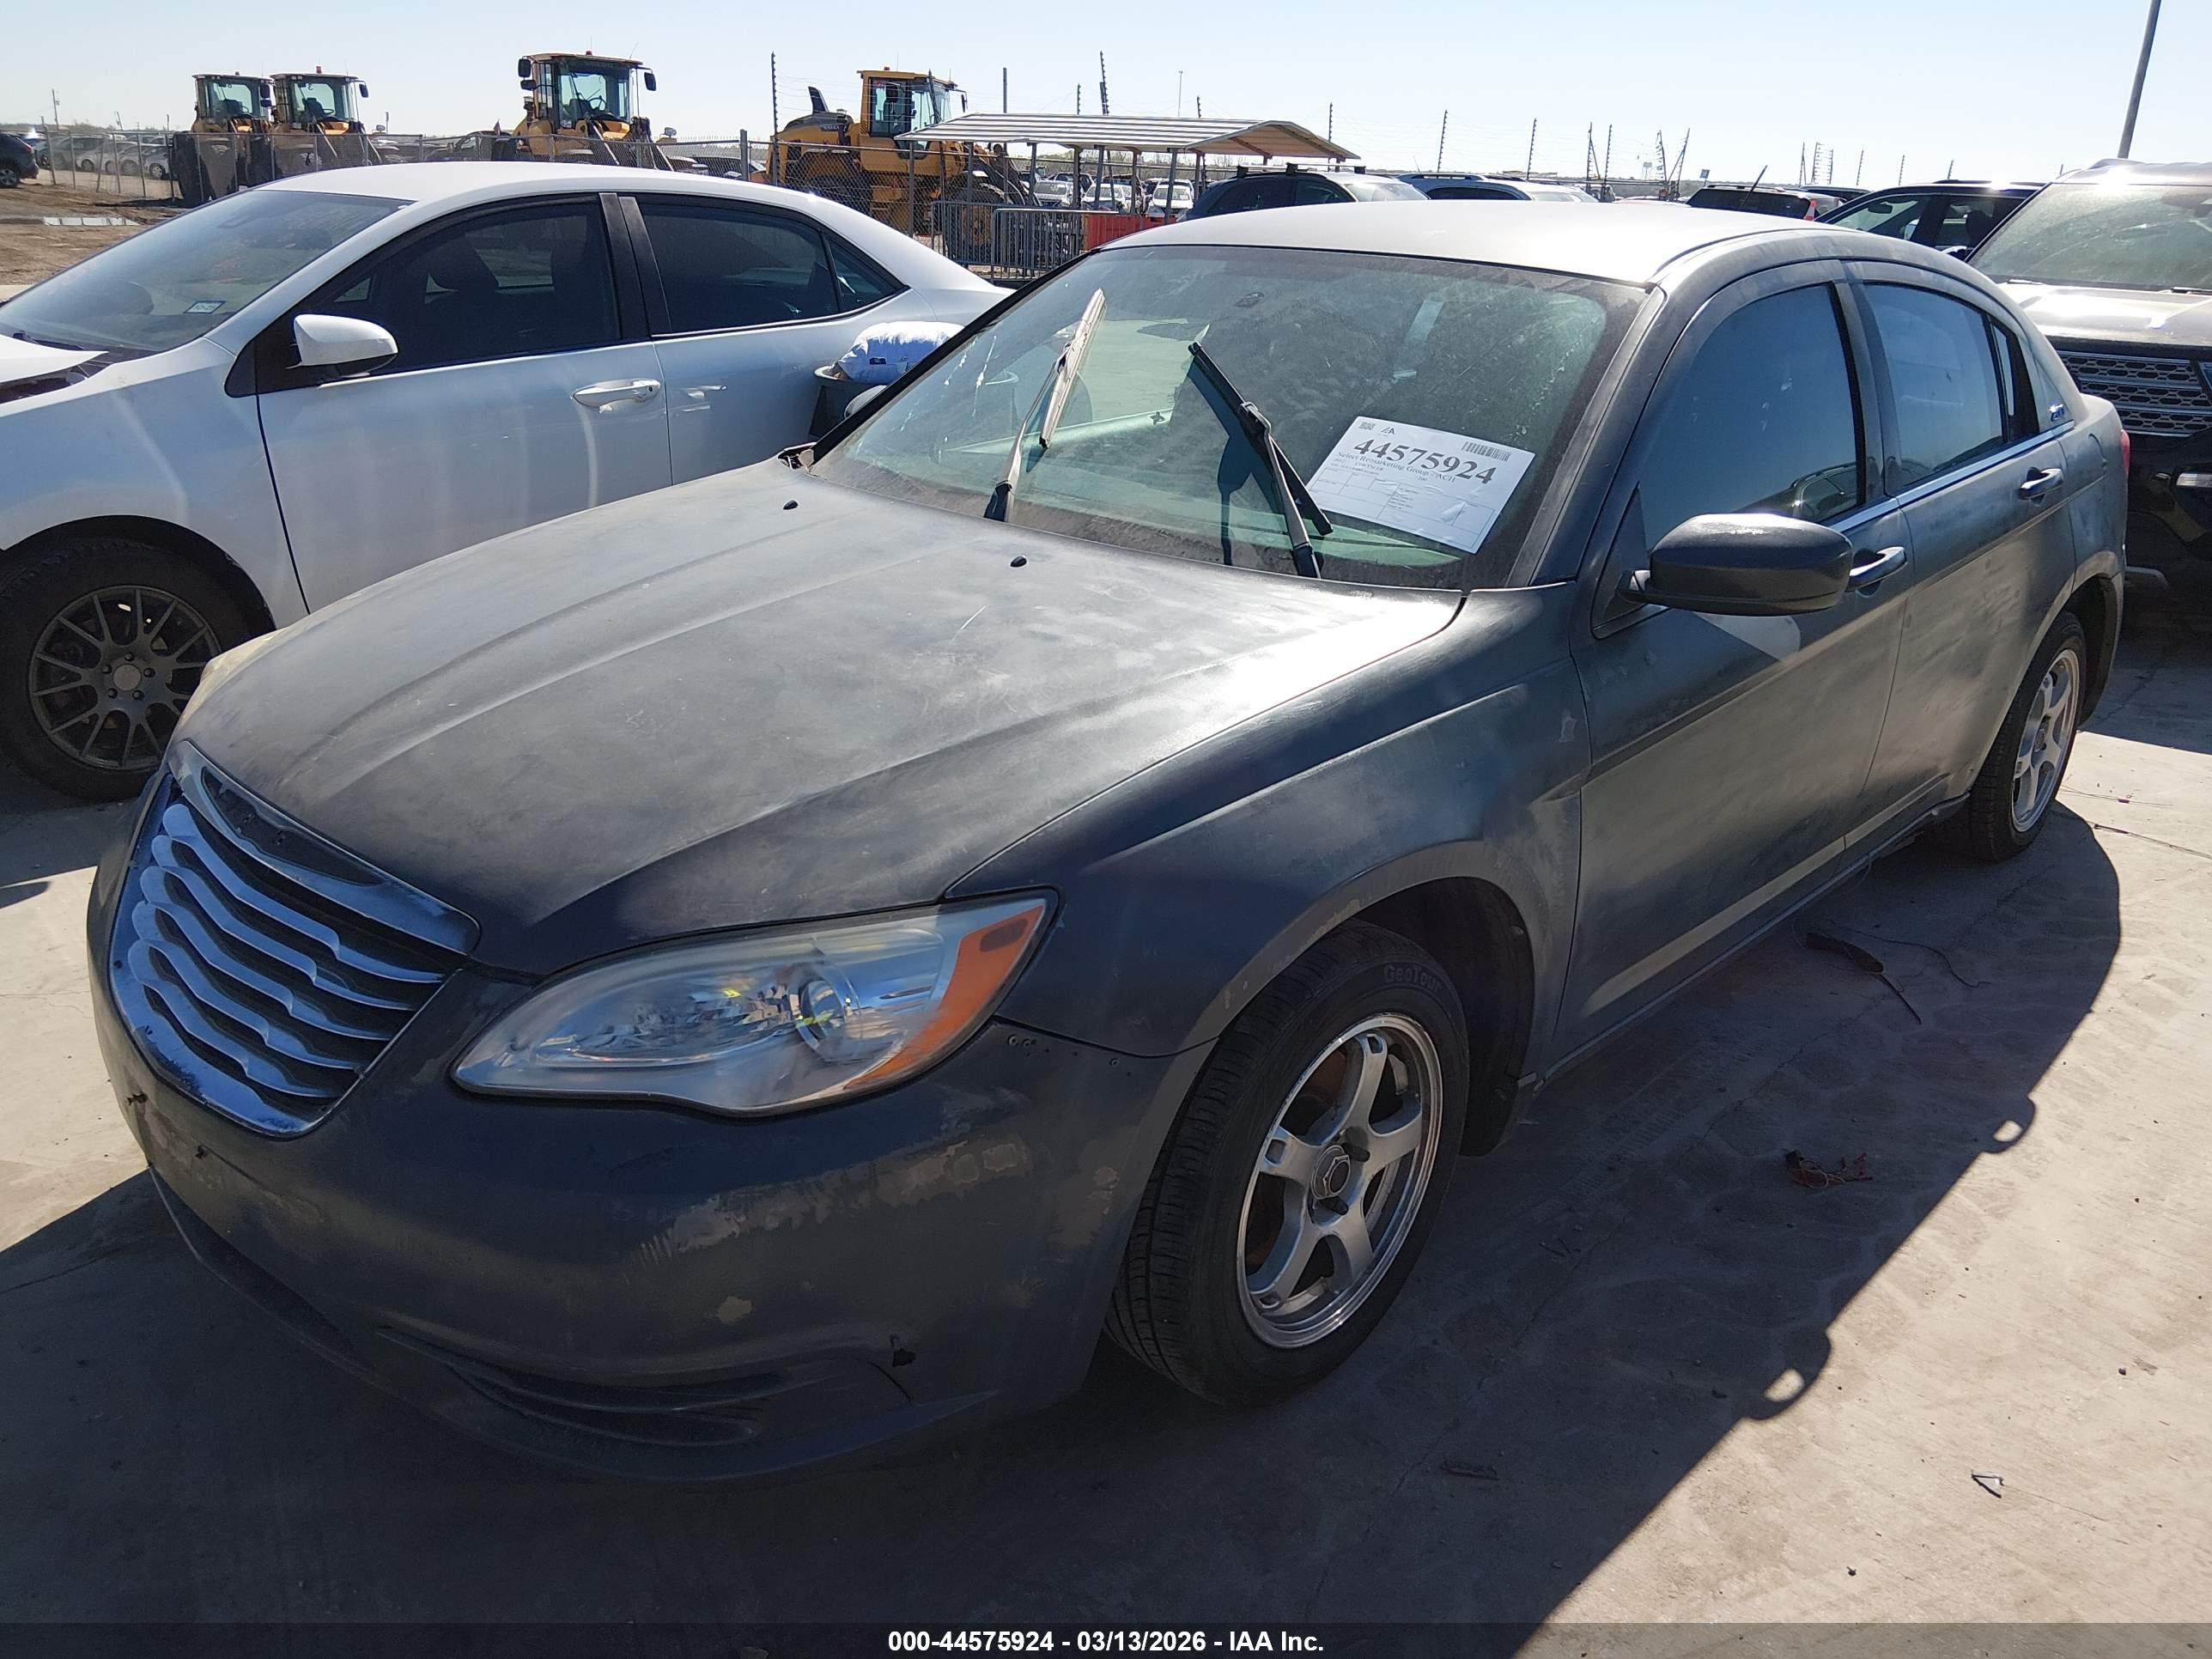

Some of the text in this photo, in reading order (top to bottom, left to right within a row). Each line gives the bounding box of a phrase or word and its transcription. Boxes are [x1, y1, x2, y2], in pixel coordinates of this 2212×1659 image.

[1353, 439, 1497, 484] 44575924
[1359, 456, 1406, 471] Remarketing
[1406, 465, 1430, 477] Group
[1383, 963, 1443, 994] GeoTour
